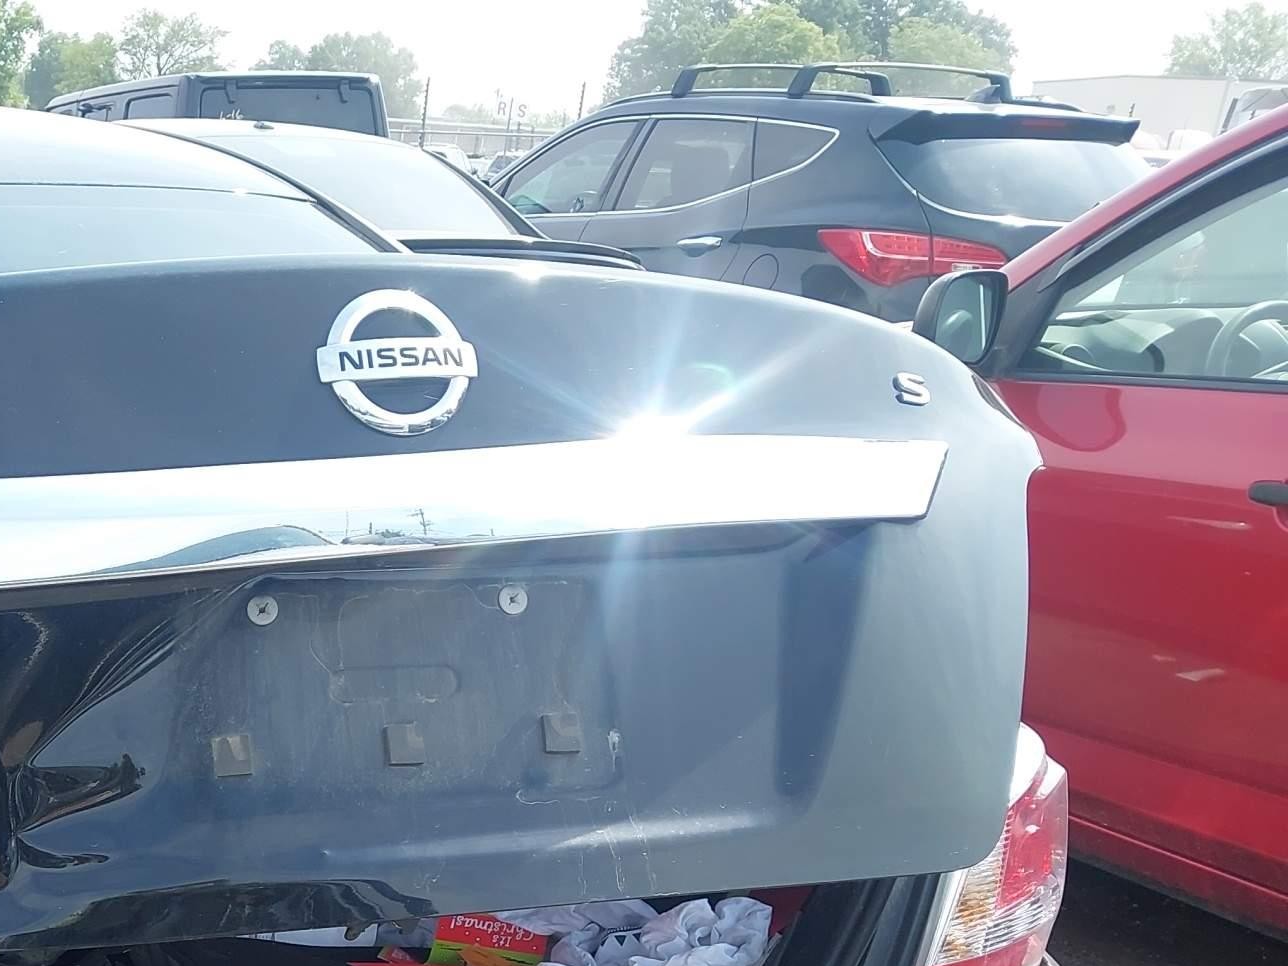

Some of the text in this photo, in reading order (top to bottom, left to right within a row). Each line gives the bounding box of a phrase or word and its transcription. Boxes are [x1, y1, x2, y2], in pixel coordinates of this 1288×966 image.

[497, 101, 528, 119] R S
[338, 346, 465, 372] NISSAN
[892, 370, 931, 407] S
